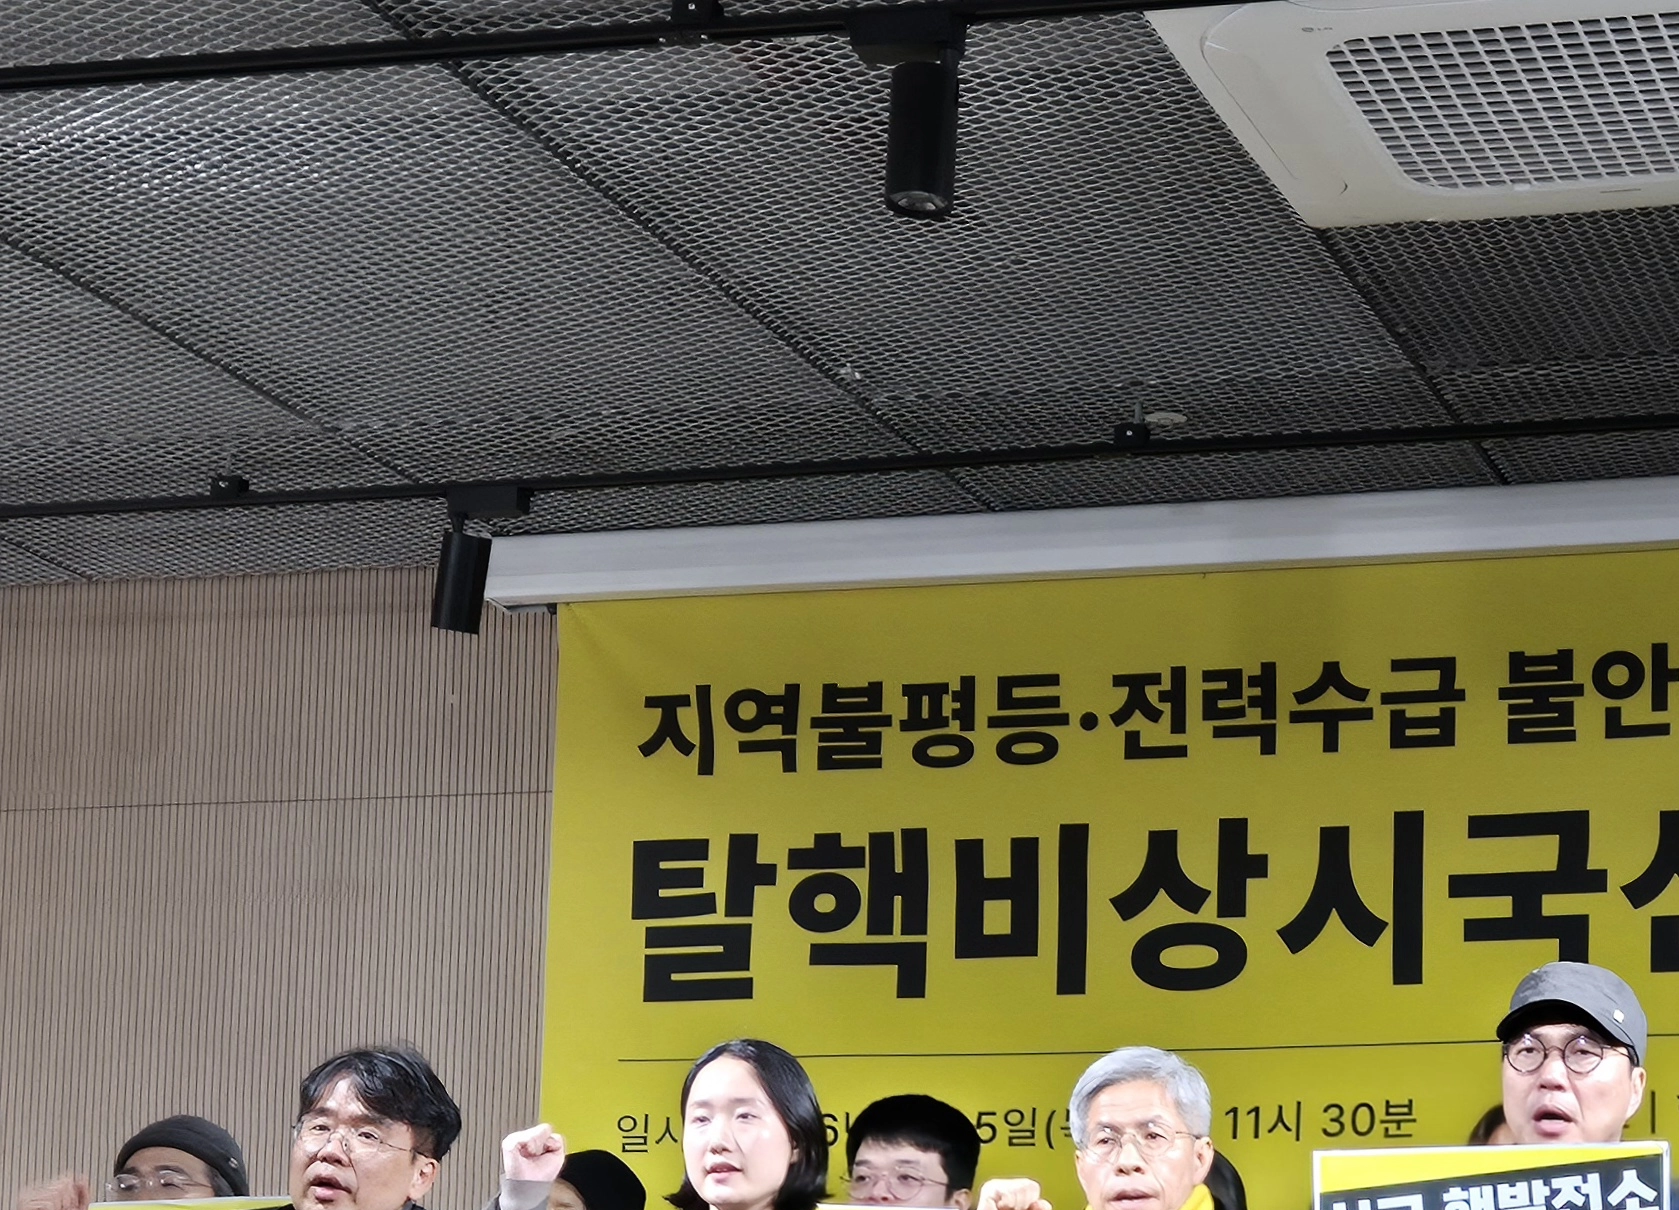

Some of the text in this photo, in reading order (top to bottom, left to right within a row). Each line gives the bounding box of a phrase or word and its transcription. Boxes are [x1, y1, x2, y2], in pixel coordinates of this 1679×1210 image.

[638, 656, 1466, 776] 지역불평등·전력수급
[1224, 1101, 1302, 1142] 11시
[1321, 1099, 1417, 1138] 30분
